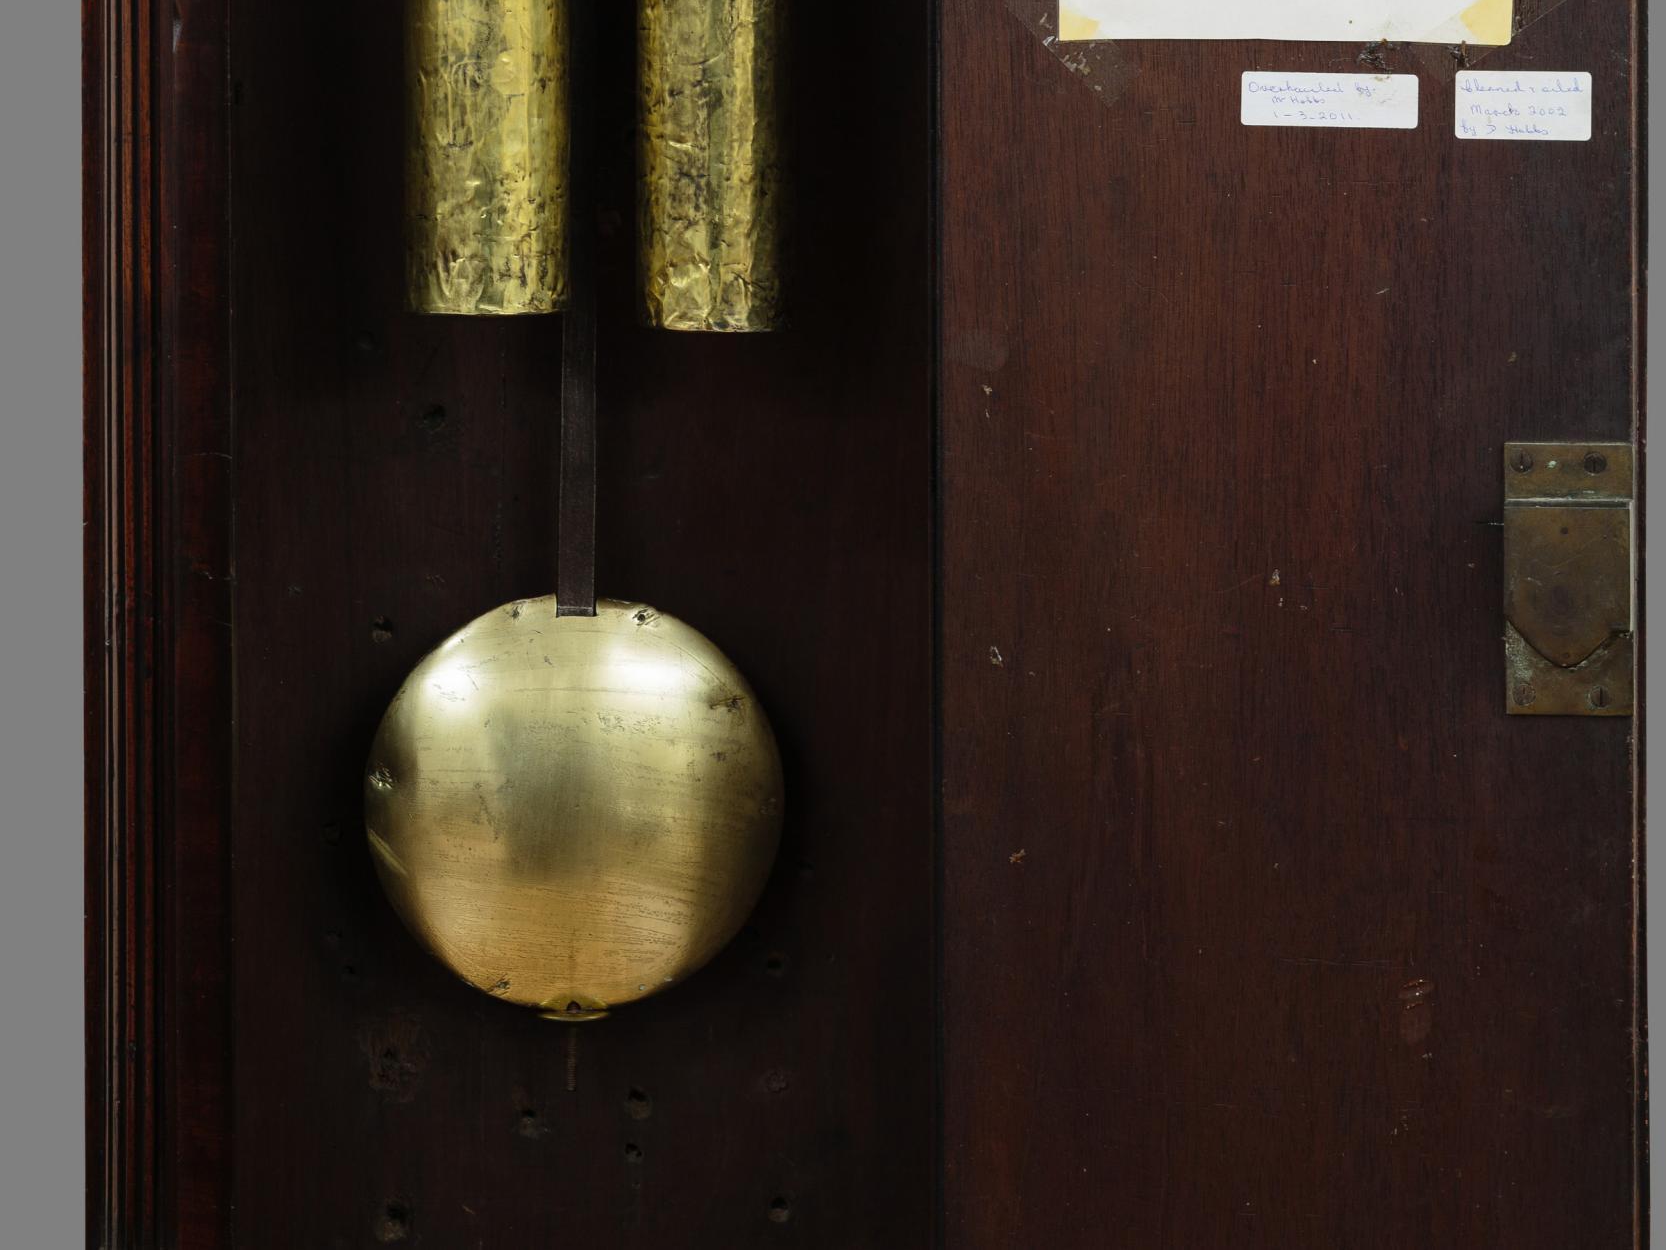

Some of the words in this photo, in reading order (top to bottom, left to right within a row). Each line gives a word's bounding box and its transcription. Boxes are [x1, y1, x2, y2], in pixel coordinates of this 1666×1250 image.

[1248, 81, 1344, 93] Overhauled
[1542, 78, 1583, 93] oiled
[1291, 96, 1325, 104] Hobbs
[1471, 103, 1520, 116] March
[1528, 105, 1566, 116] 2002
[1461, 120, 1477, 136] by
[1506, 124, 1550, 135] Hobbs
